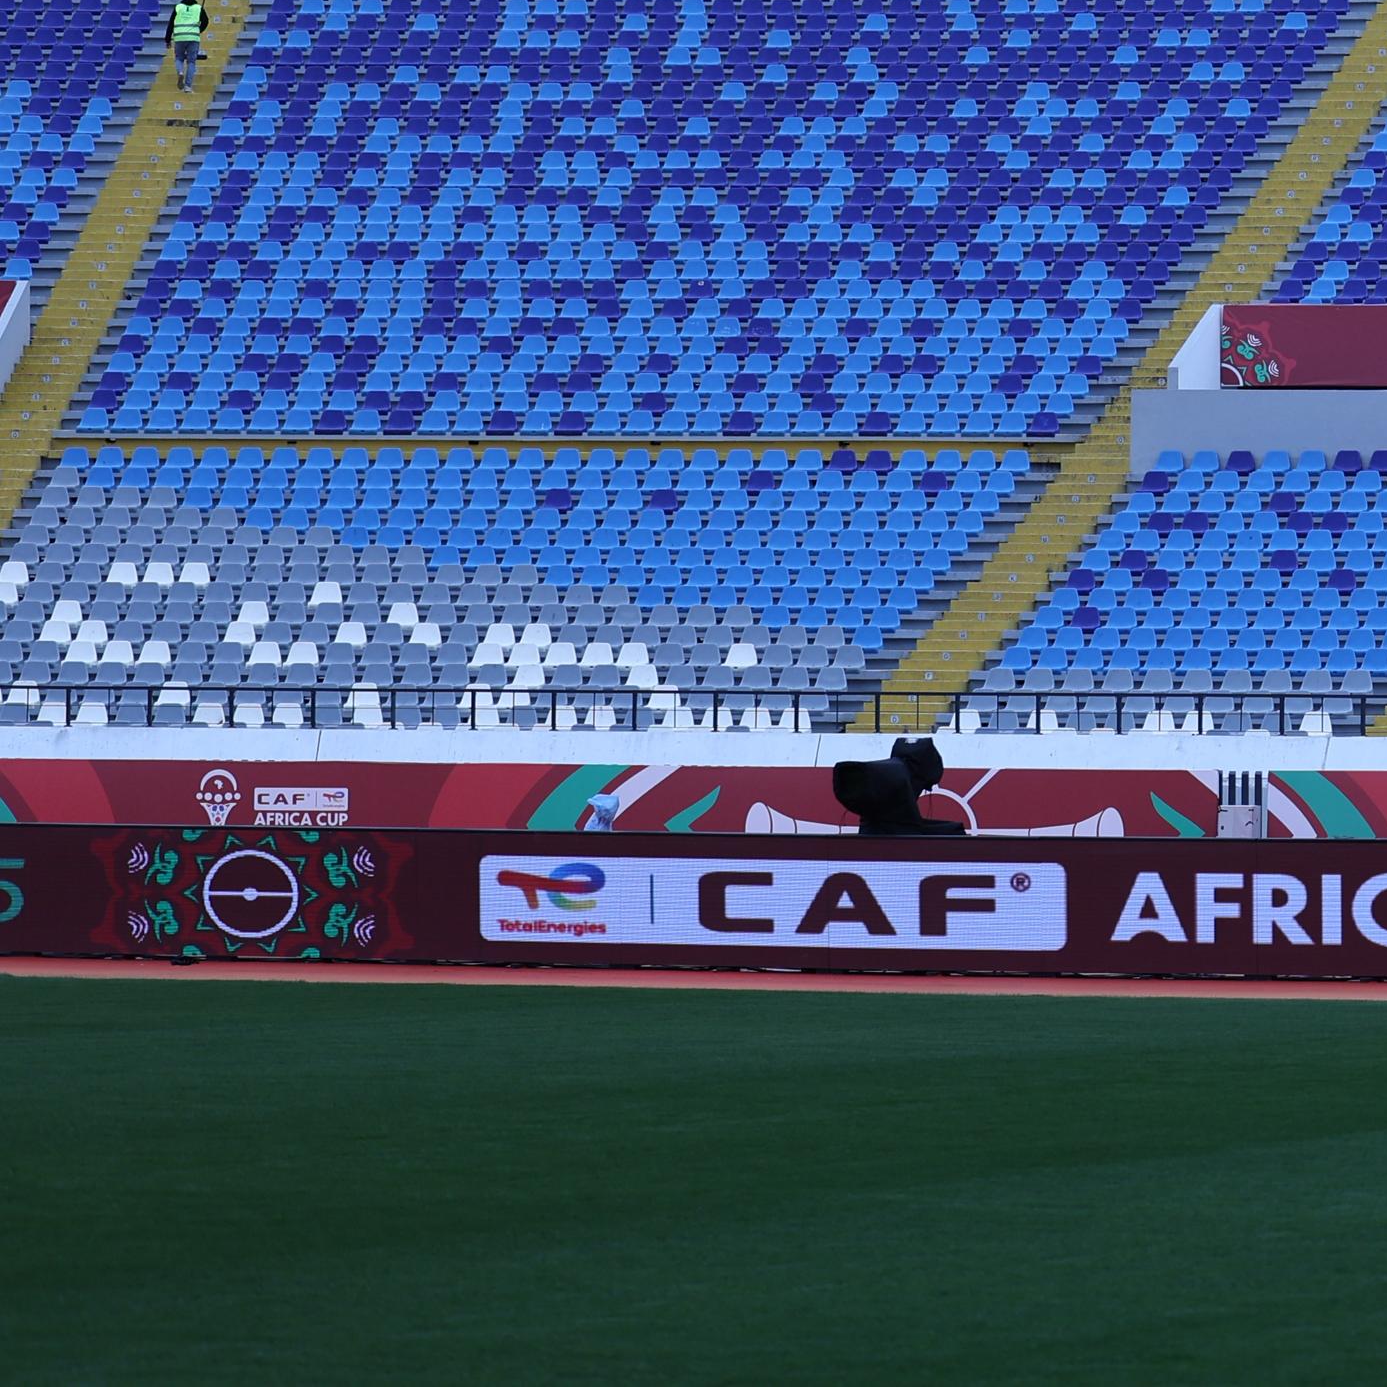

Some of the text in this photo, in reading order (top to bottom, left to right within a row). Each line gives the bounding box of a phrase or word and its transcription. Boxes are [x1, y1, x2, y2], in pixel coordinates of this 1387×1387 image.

[258, 794, 304, 805] CAF
[254, 813, 348, 826] AFRICA CUP
[496, 919, 606, 937] TotalEnergies
